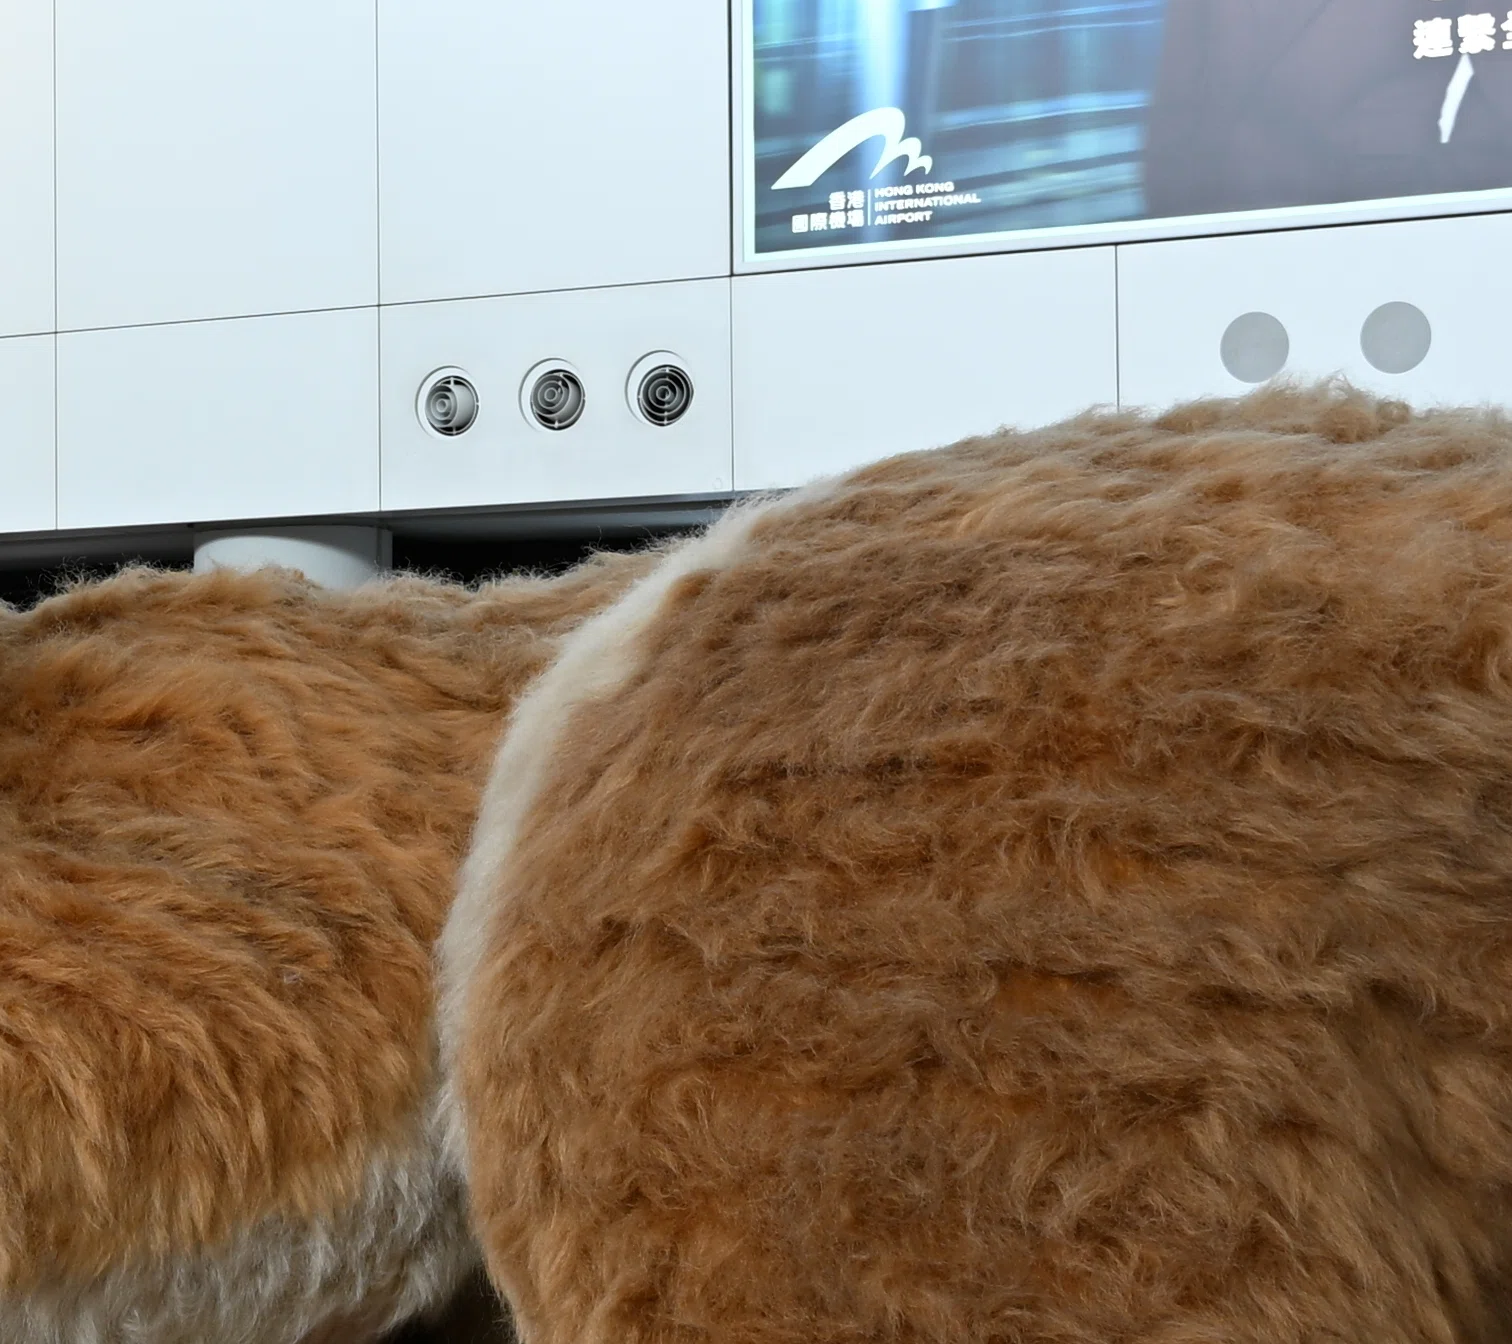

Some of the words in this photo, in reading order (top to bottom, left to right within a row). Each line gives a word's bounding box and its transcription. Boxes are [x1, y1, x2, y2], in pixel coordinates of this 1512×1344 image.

[874, 185, 913, 198] HONG
[916, 181, 955, 194] KONG
[829, 190, 865, 211] 香港
[874, 193, 982, 212] INTERNATIONAL
[791, 210, 865, 234] 國際機場
[874, 211, 933, 225] AIRPORT
